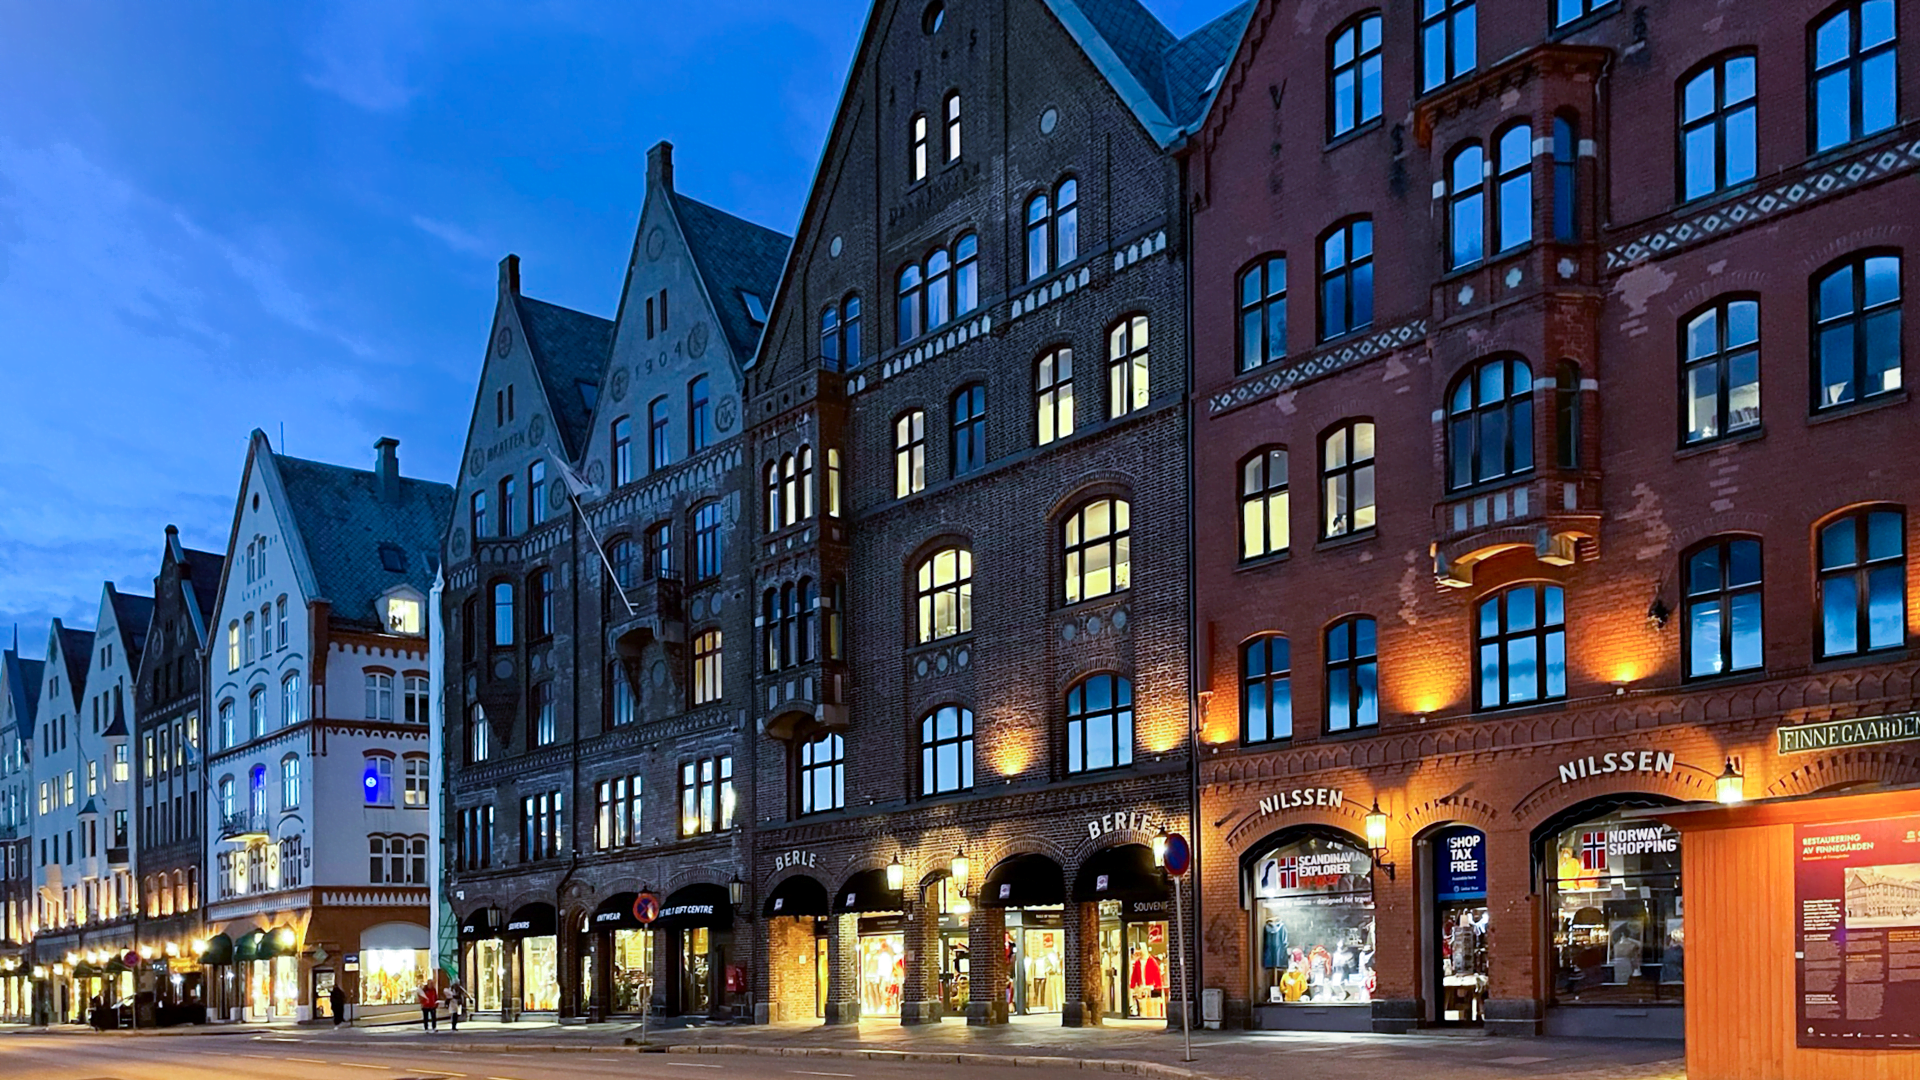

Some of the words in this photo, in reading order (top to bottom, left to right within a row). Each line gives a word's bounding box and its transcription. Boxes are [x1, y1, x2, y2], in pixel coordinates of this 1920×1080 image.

[635, 340, 682, 381] 1904
[1559, 751, 1675, 783] NILSSEN
[1259, 788, 1343, 816] NILSSEN
[1088, 812, 1152, 840] BERLE
[1450, 835, 1480, 848] SHOP
[1609, 827, 1663, 842] NORWAY
[1802, 834, 1861, 845] RESTAURERING
[1450, 848, 1472, 860] TAX
[1609, 839, 1677, 855] SHOPPING
[775, 850, 816, 871] BERLE
[1299, 852, 1370, 866] SCANDINAVIAN
[1450, 860, 1478, 872] FREE
[1300, 863, 1350, 877] EXPLORER
[688, 905, 714, 914] CENTRE
